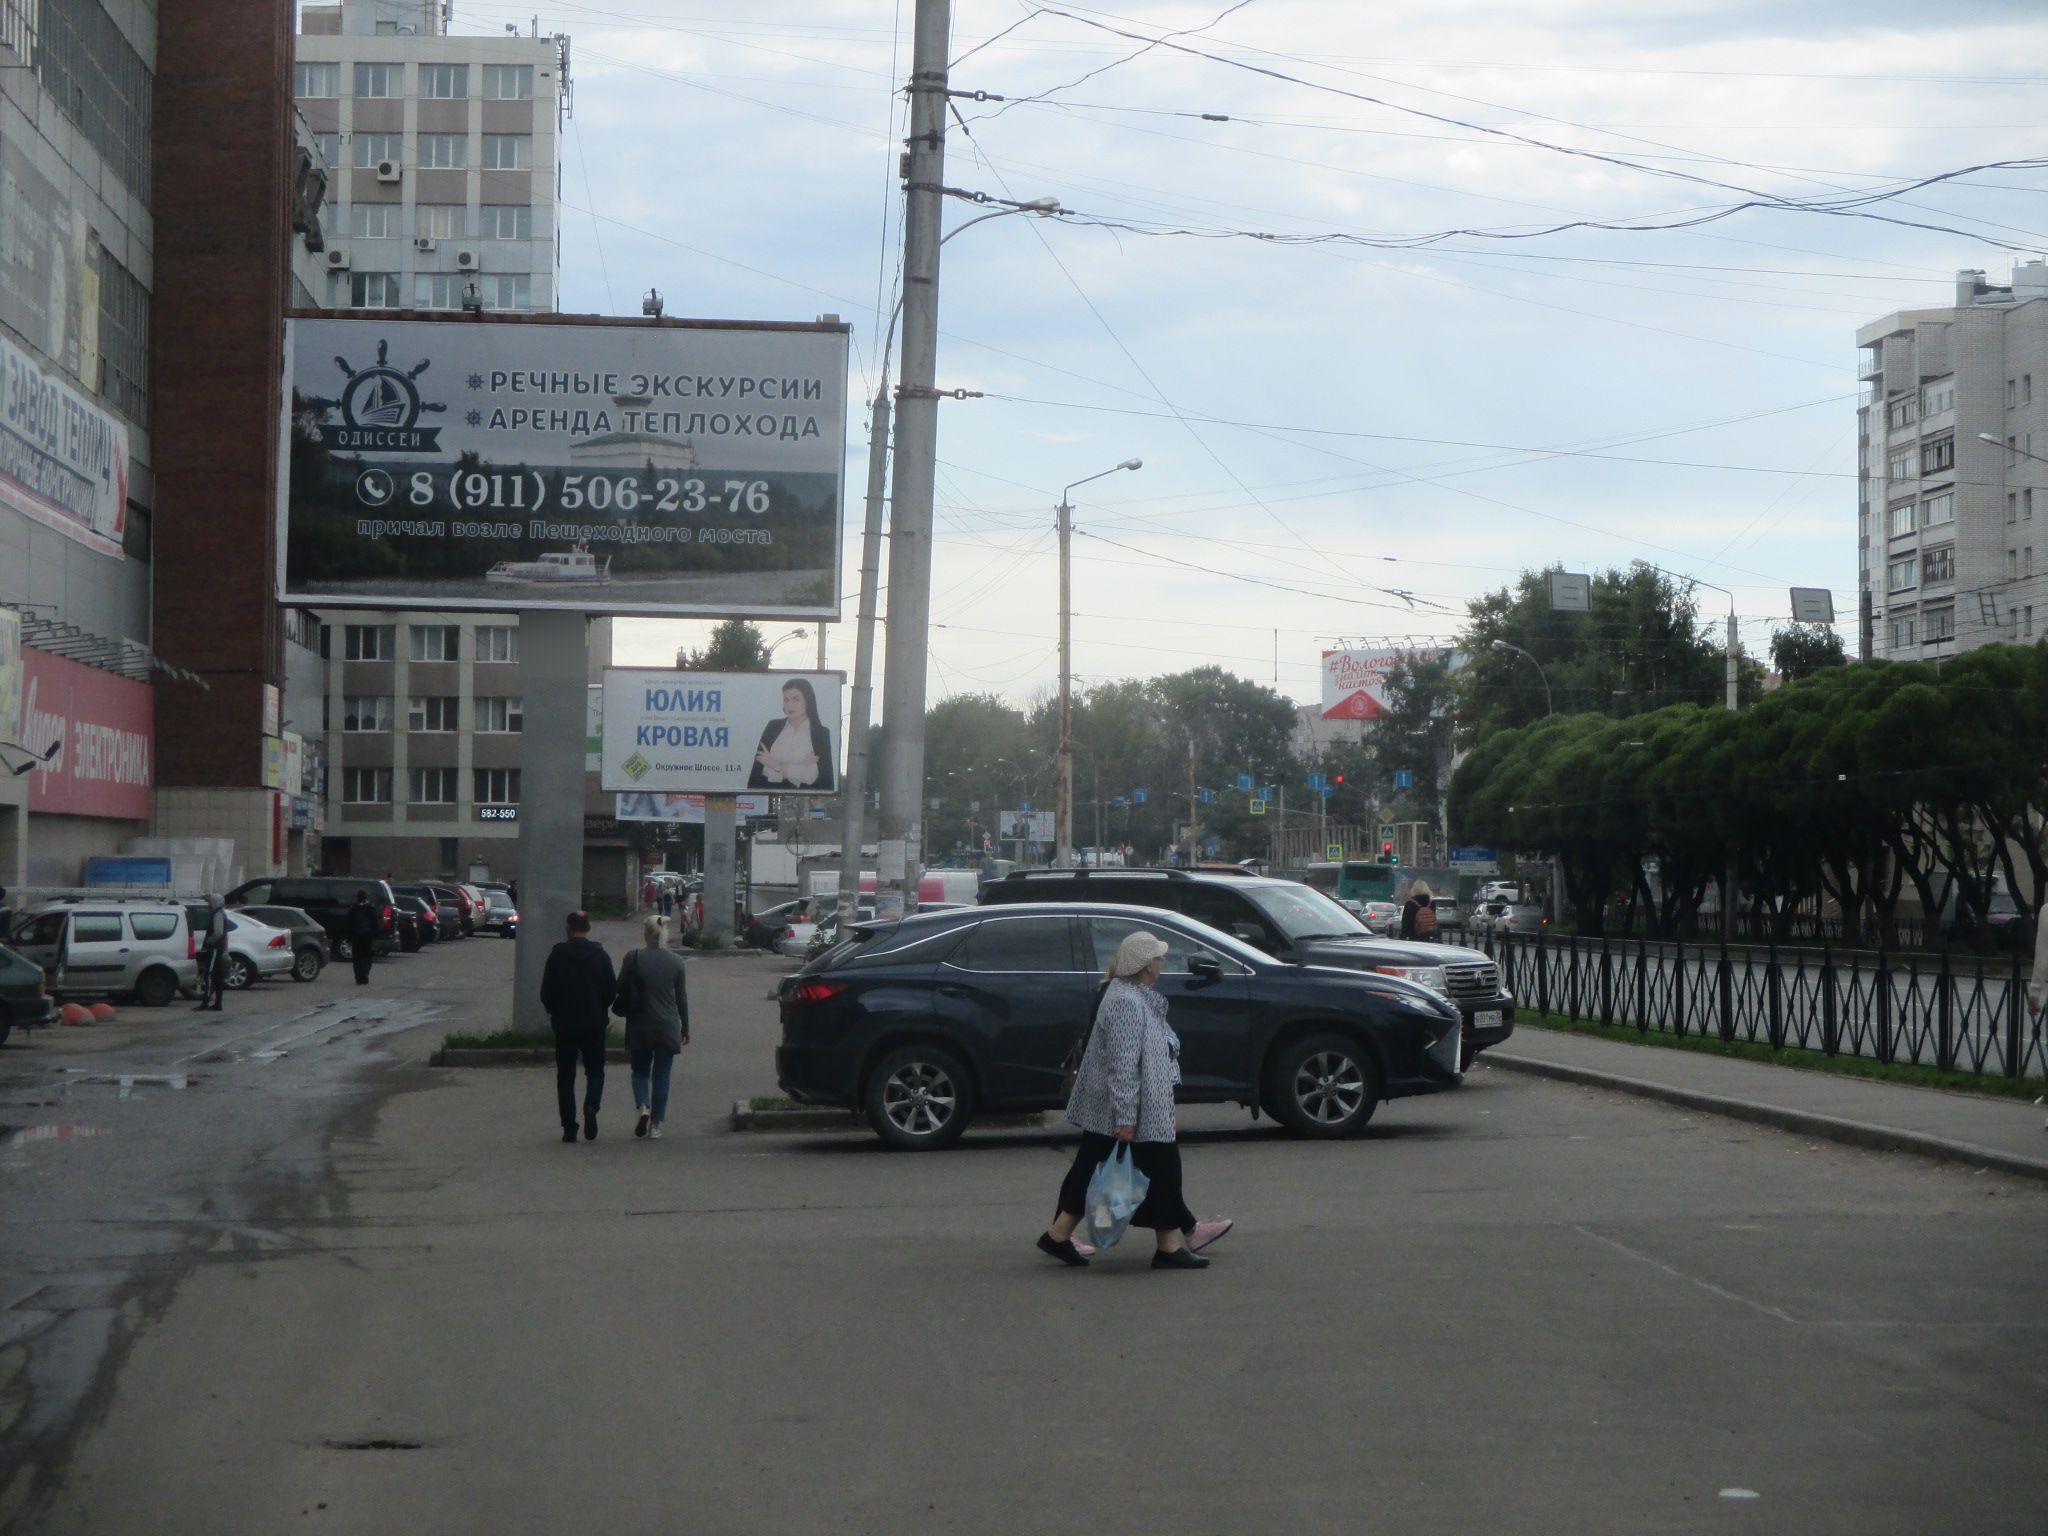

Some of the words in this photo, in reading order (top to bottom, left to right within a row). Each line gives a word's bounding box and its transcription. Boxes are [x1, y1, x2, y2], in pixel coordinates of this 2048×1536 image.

[490, 370, 618, 395] РЕЧНЫЕ
[630, 374, 822, 400] ЭКСКУРСИИ
[9, 353, 58, 458] ЗАВОД
[488, 408, 612, 436] АРЕНДА
[624, 411, 820, 441] ТЕПЛОХОДА
[409, 471, 434, 505] 8
[450, 469, 546, 511] (911)
[560, 475, 770, 513] 506-23-76
[357, 519, 445, 539] причал
[452, 522, 522, 538] возле
[529, 520, 691, 543] Пешеходного
[698, 528, 772, 544] моста
[645, 688, 722, 713] ЮЛИЯ
[636, 725, 729, 747] КРОВЛЯ
[74, 720, 150, 786] ЭЛЕКТРОНИКА
[481, 808, 516, 819] 582-550
